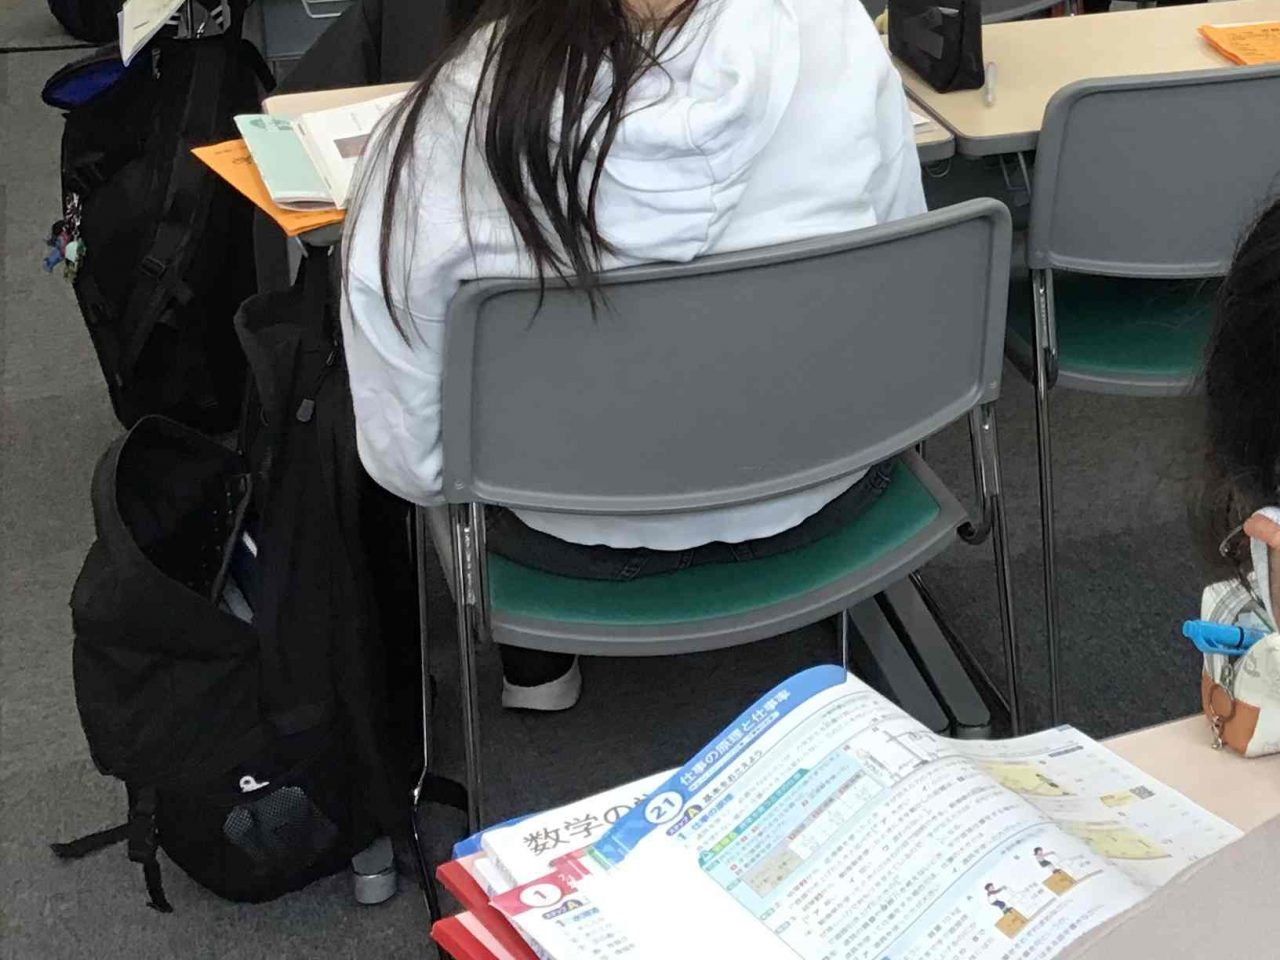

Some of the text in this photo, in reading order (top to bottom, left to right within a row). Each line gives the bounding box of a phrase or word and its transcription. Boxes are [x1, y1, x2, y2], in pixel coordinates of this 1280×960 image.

[679, 689, 790, 786] 仕事の原理と仕事率
[523, 794, 650, 856] 数学の
[650, 798, 676, 820] 21
